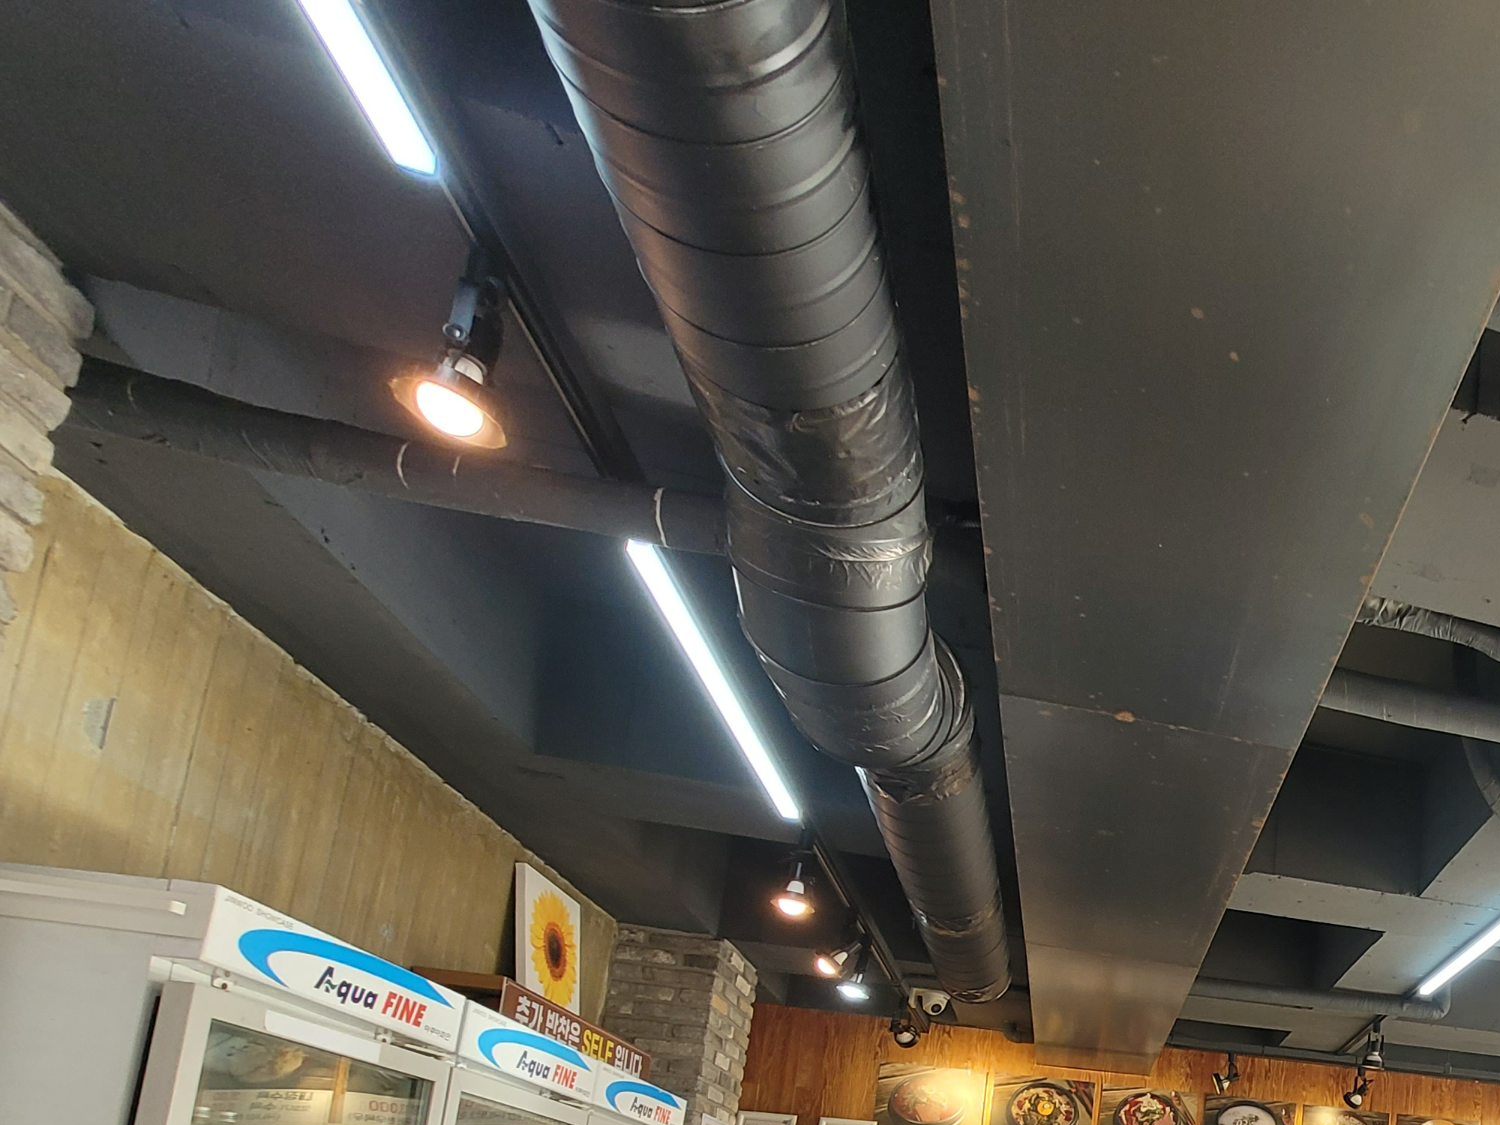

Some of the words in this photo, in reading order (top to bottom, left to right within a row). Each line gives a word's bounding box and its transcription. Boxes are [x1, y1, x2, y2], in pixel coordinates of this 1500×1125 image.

[314, 966, 379, 1010] Aqua
[381, 991, 427, 1027] FINE
[515, 995, 543, 1033] 추가
[545, 1008, 581, 1050] 반찬은
[581, 1029, 615, 1063] SELF
[614, 1044, 643, 1079] 입니다
[516, 1050, 551, 1079] Aqua
[552, 1064, 577, 1090] FINE
[630, 1096, 653, 1119] Aqua
[654, 1106, 672, 1125] FINE
